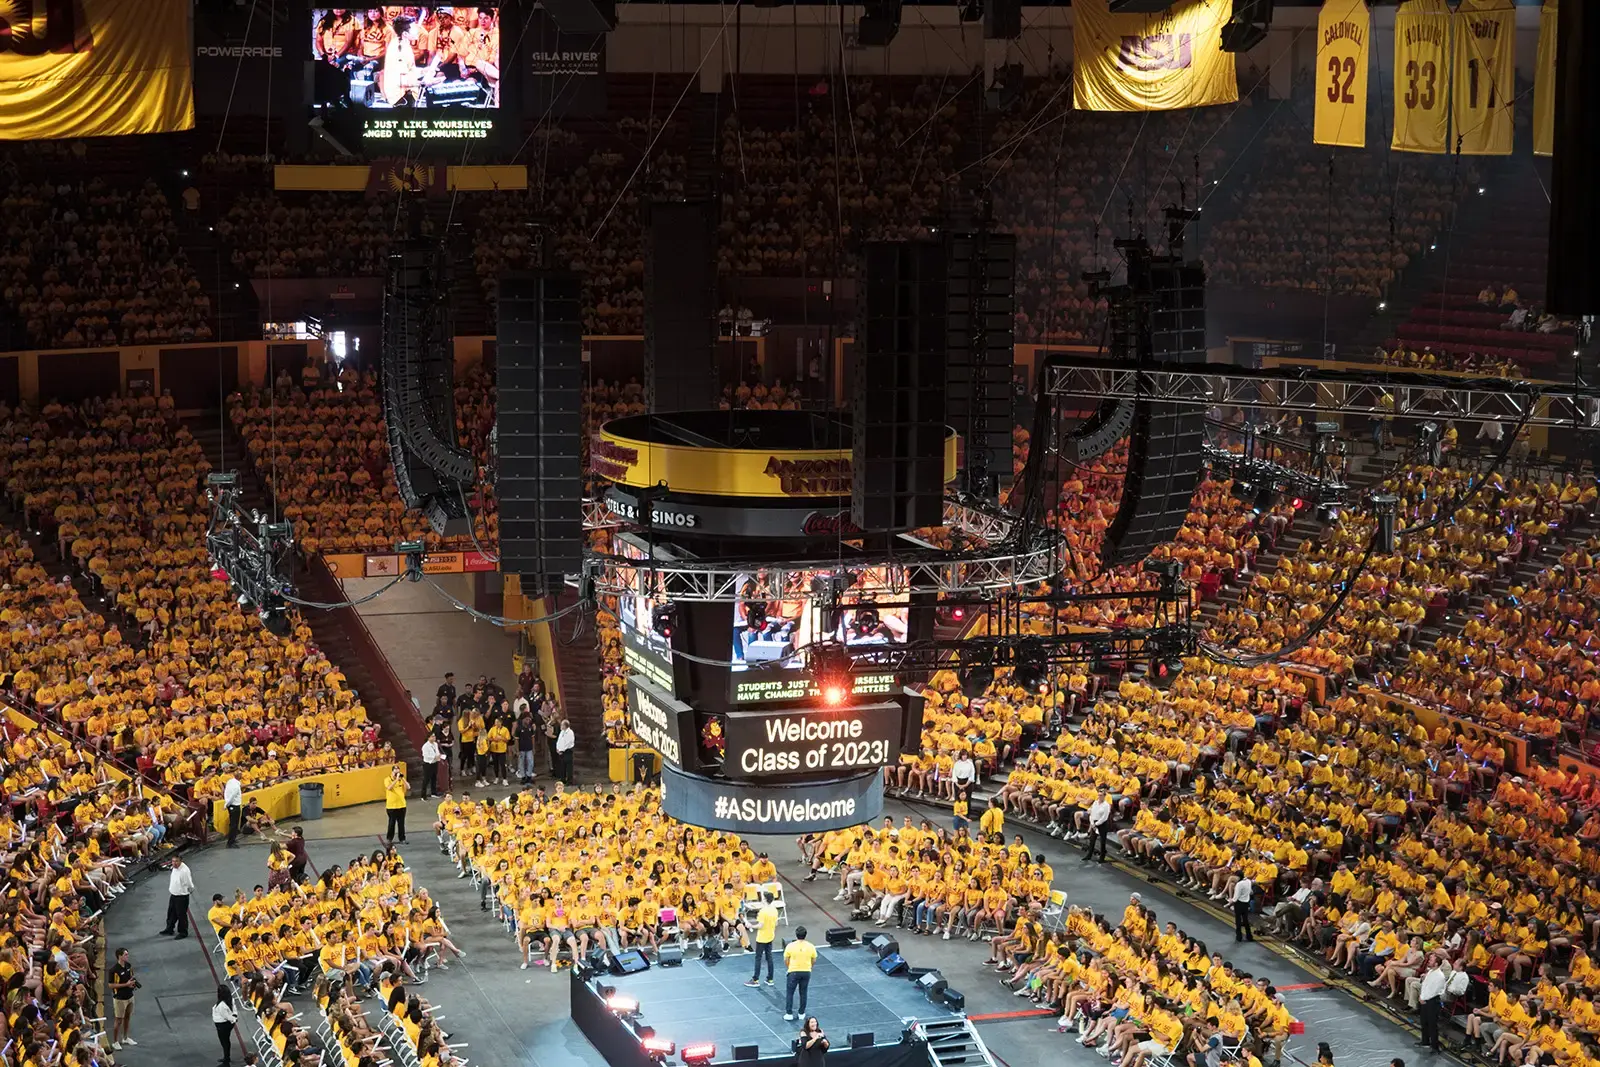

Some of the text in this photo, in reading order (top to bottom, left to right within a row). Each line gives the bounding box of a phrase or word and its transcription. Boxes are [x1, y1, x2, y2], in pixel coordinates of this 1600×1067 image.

[1324, 21, 1362, 46] CALDWELL
[1470, 20, 1499, 40] COTT
[197, 47, 282, 58] POWERADE
[532, 52, 598, 60] GILA RIVER
[1328, 56, 1356, 104] 32
[1404, 60, 1436, 110] 33
[398, 130, 416, 138] THE
[422, 130, 487, 138] COMMUNITIES
[627, 506, 634, 518] &
[737, 692, 760, 700] HAVE
[764, 690, 804, 699] CHANGED
[738, 682, 782, 692] STUDENTS
[788, 680, 810, 689] JUST
[636, 688, 668, 730] Welcome
[766, 717, 862, 742] Welcome
[742, 740, 890, 773] Class of 2023!
[714, 796, 856, 822] #ASUWelcome
